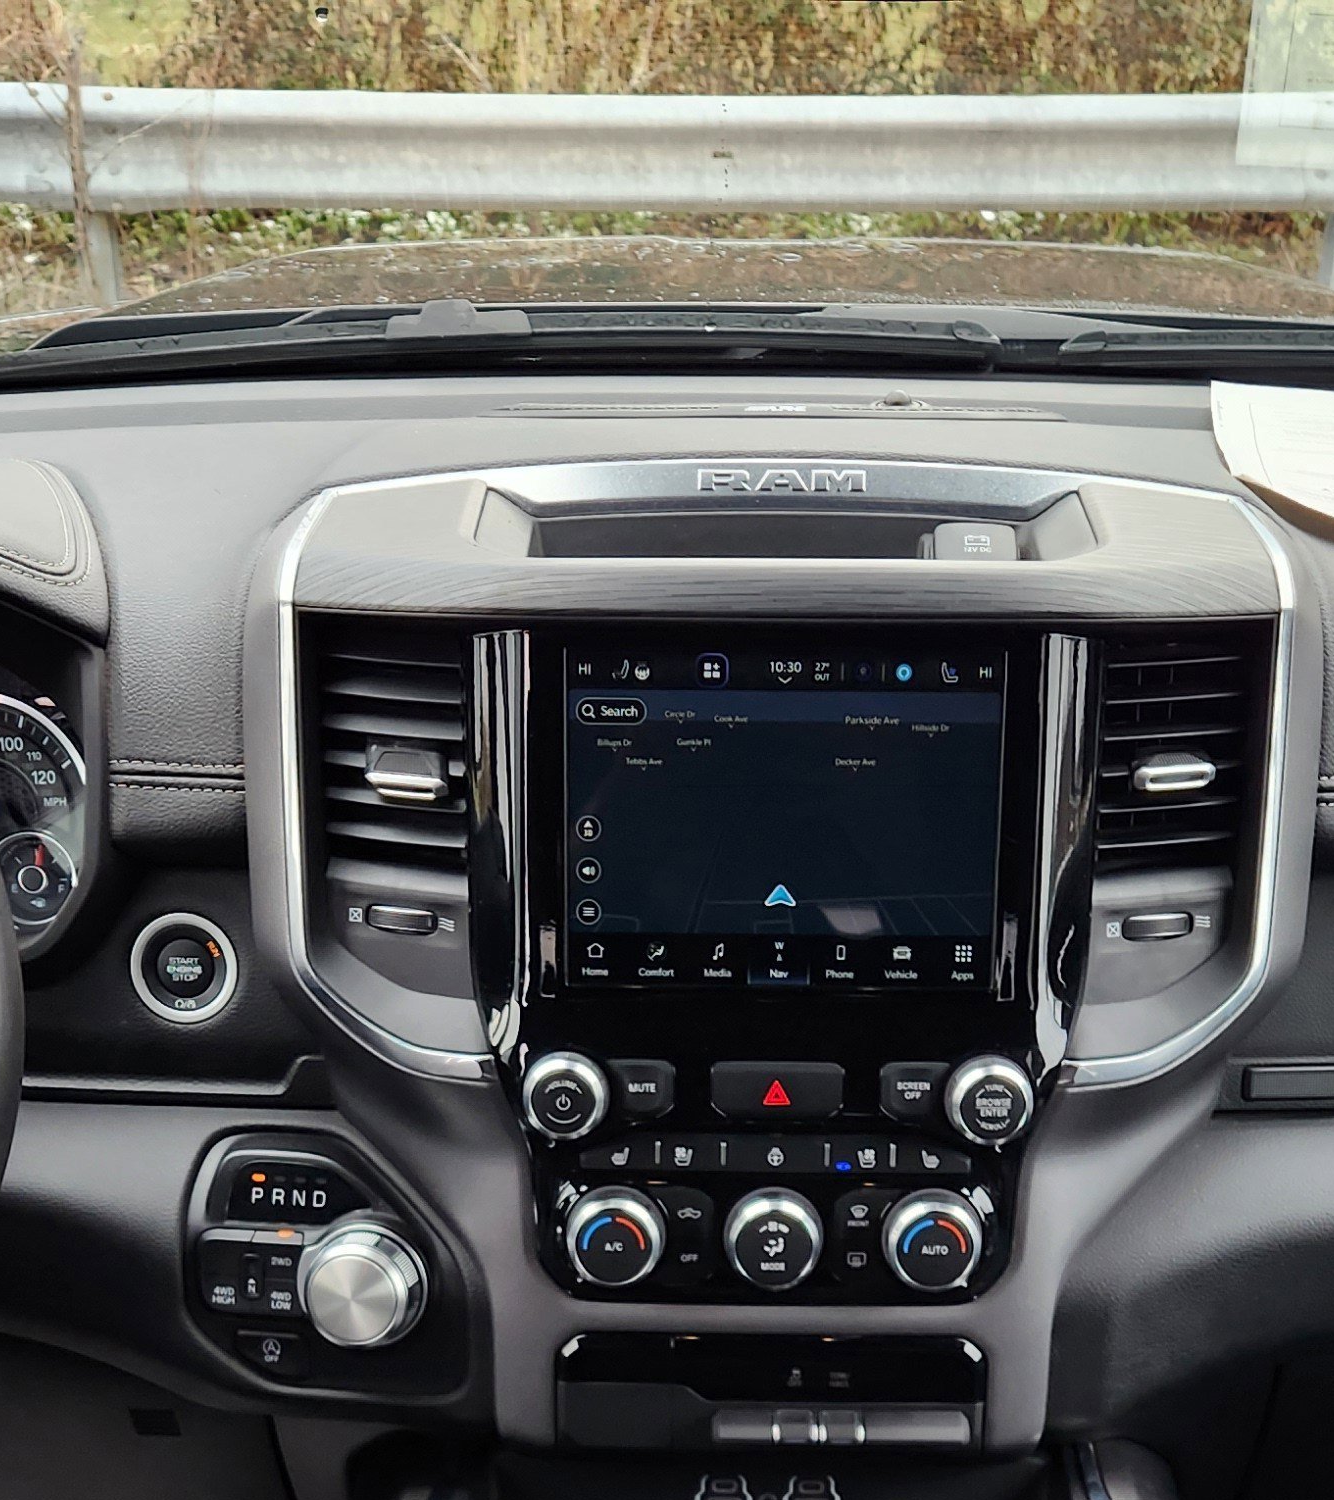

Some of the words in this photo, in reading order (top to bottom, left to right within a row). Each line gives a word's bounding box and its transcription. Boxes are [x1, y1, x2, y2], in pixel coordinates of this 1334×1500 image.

[697, 468, 866, 492] RAM
[578, 663, 592, 676] HI
[769, 661, 803, 674] 10:30
[979, 666, 993, 679] HI
[814, 673, 830, 682] OUT
[600, 705, 639, 718] Search
[845, 715, 882, 725] Parkside
[883, 716, 900, 725] Ave
[26, 751, 42, 762] 110
[835, 757, 861, 766] Decker
[862, 758, 876, 766] Ave
[31, 770, 56, 785] 120
[43, 797, 67, 807] MPH
[58, 883, 65, 893] F
[168, 956, 200, 965] START
[172, 973, 199, 982] STOP
[581, 967, 609, 977] Home
[638, 967, 675, 978] Comfort
[703, 967, 732, 978] Media
[769, 969, 789, 979] Nav
[825, 969, 854, 980] Phone
[884, 969, 918, 980] Vehicle
[951, 970, 974, 981] Apps
[628, 1082, 657, 1093] MUTE
[896, 1081, 931, 1091] SCREEN
[904, 1091, 922, 1100] OFF
[980, 1108, 1008, 1118] ENTER
[251, 1186, 264, 1204] P
[271, 1187, 285, 1206] R
[292, 1189, 306, 1207] N
[312, 1190, 327, 1208] D
[604, 1241, 623, 1252] A/C
[921, 1245, 949, 1256] AUTO
[270, 1256, 293, 1267] 2WD
[680, 1253, 699, 1262] OFF
[213, 1285, 235, 1296] 4WD
[248, 1284, 256, 1294] N
[211, 1295, 236, 1305] HIGH
[270, 1291, 292, 1301] 4WD
[270, 1300, 292, 1310] LOW
